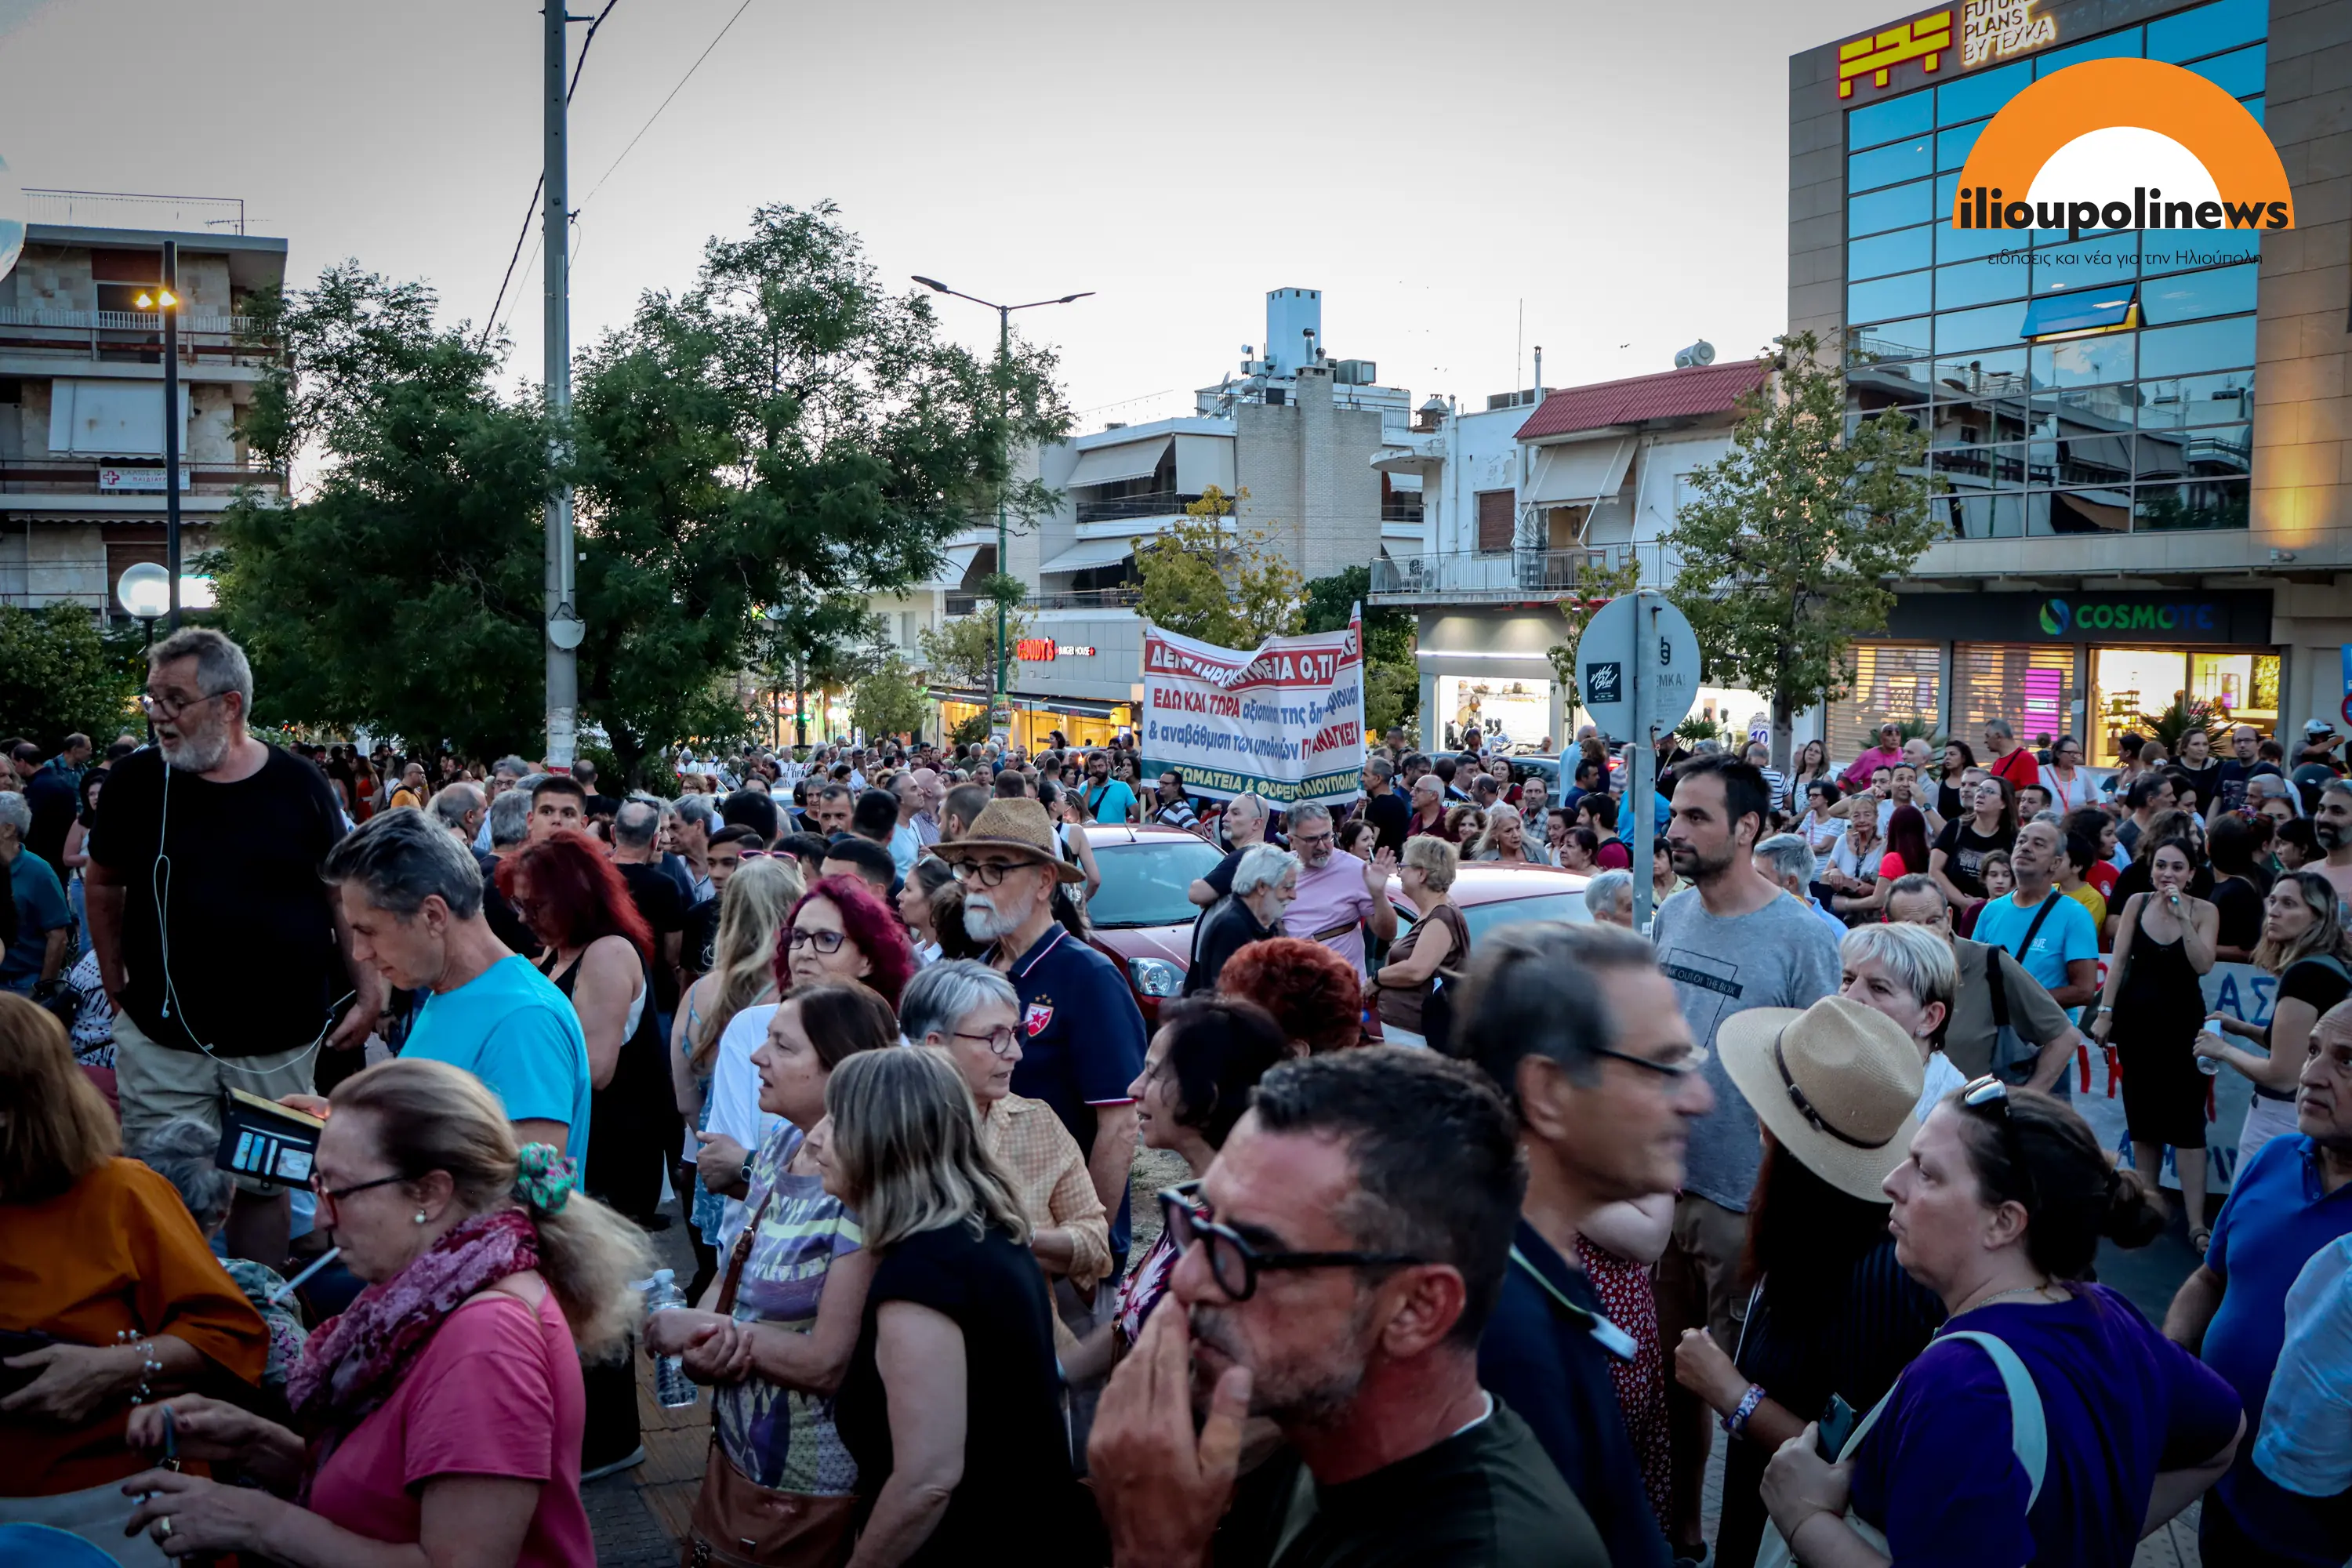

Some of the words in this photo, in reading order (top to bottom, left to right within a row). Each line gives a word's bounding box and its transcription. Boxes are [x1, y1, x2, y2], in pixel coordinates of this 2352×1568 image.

[1965, 9, 2023, 41] PLANS
[1964, 38, 1987, 60] BY
[2076, 604, 2214, 630] COSMOTE
[1058, 645, 1074, 655] BURGER
[1075, 645, 1090, 656] HOUSE
[1272, 655, 1296, 681] ΙΑ
[1300, 655, 1334, 684] Ο,ΤΙ
[1153, 688, 1181, 710] ΕΔΩ
[1184, 691, 1207, 713] ΚΑΙ
[1209, 694, 1240, 718] ΤΩΡΑ
[1280, 706, 1306, 728] της
[1309, 701, 1325, 724] δη
[1149, 720, 1158, 740] &
[1161, 723, 1231, 751] αναβάθμιση
[1312, 720, 1356, 753] ΑΝΑΓΚΕΣ
[1245, 778, 1254, 793] &
[1257, 780, 1298, 800] ΦΟΡΕΙ
[1719, 982, 1736, 996] BOX
